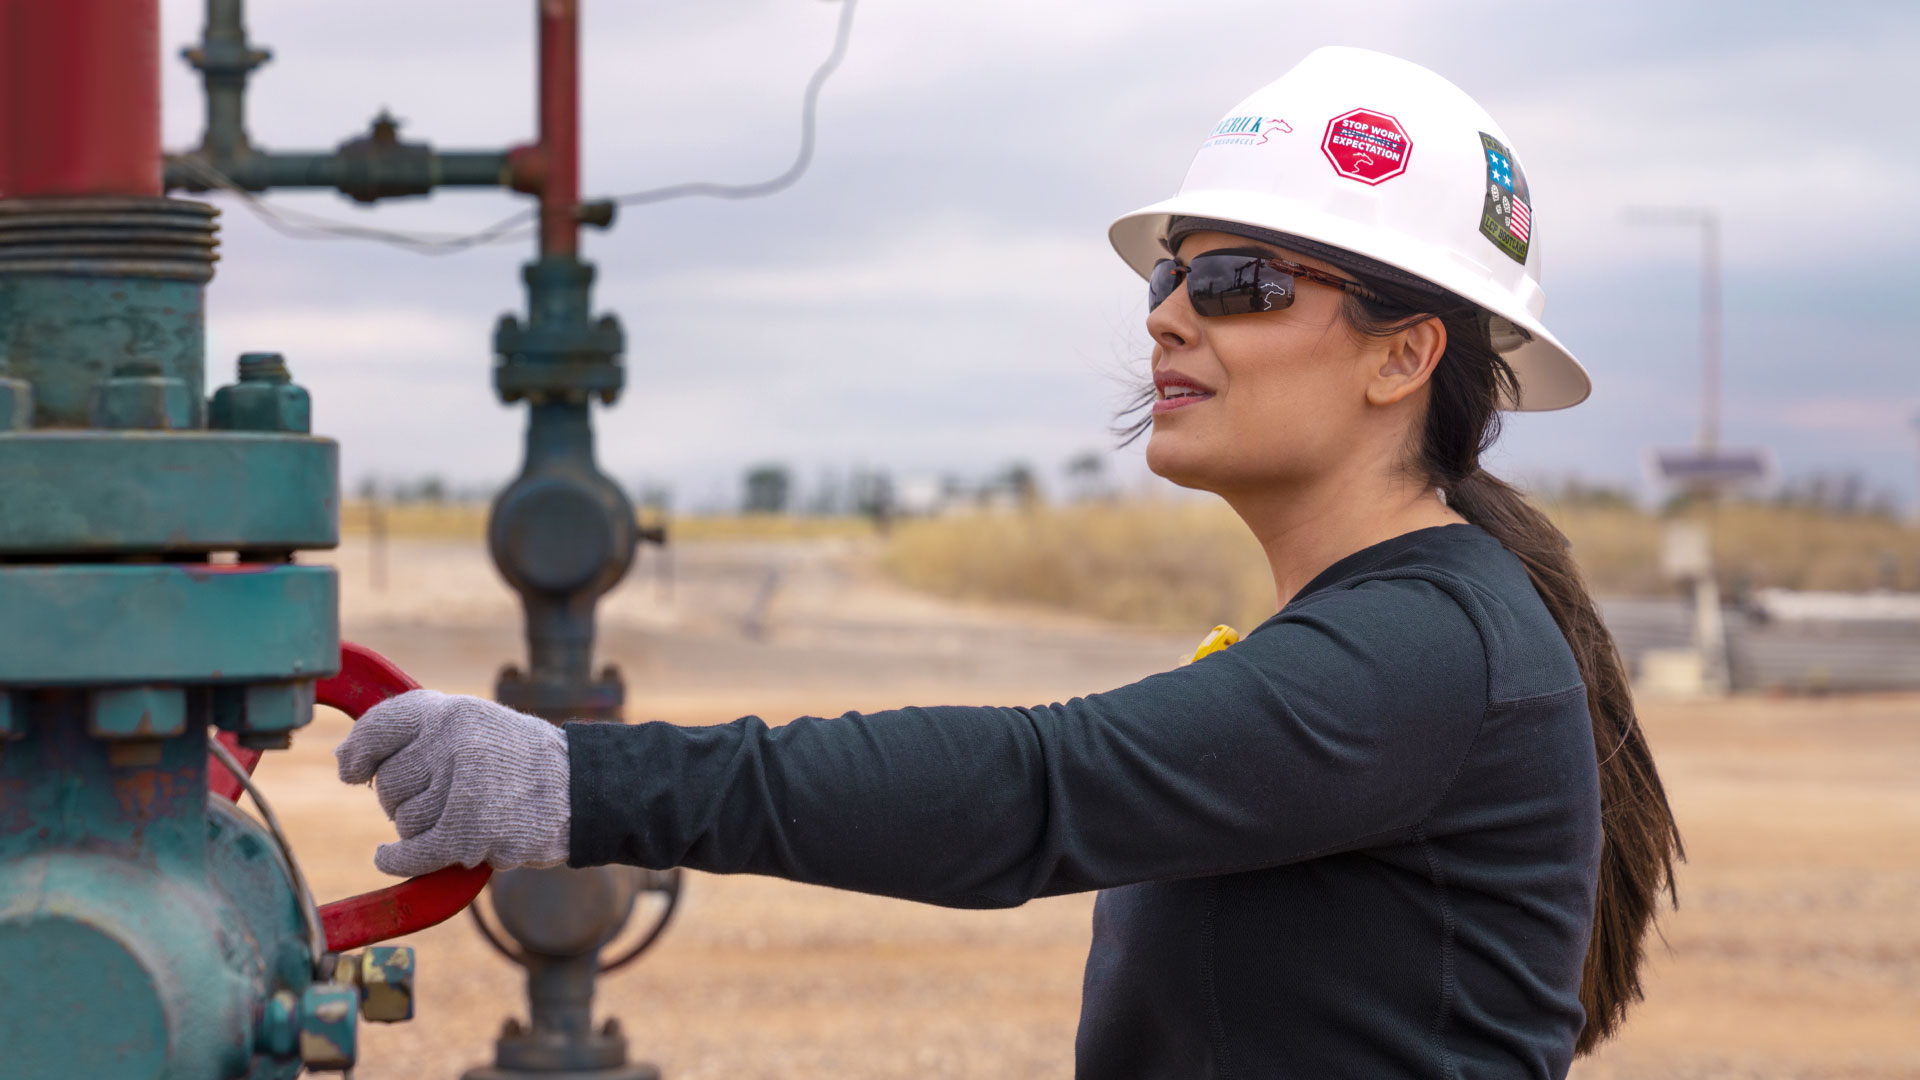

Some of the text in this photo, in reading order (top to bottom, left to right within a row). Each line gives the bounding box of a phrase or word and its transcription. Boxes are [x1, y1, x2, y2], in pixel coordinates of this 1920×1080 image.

[1342, 120, 1401, 142] STOP WORK
[1332, 135, 1400, 162] EXPECTATION
[1485, 216, 1498, 233] LCP
